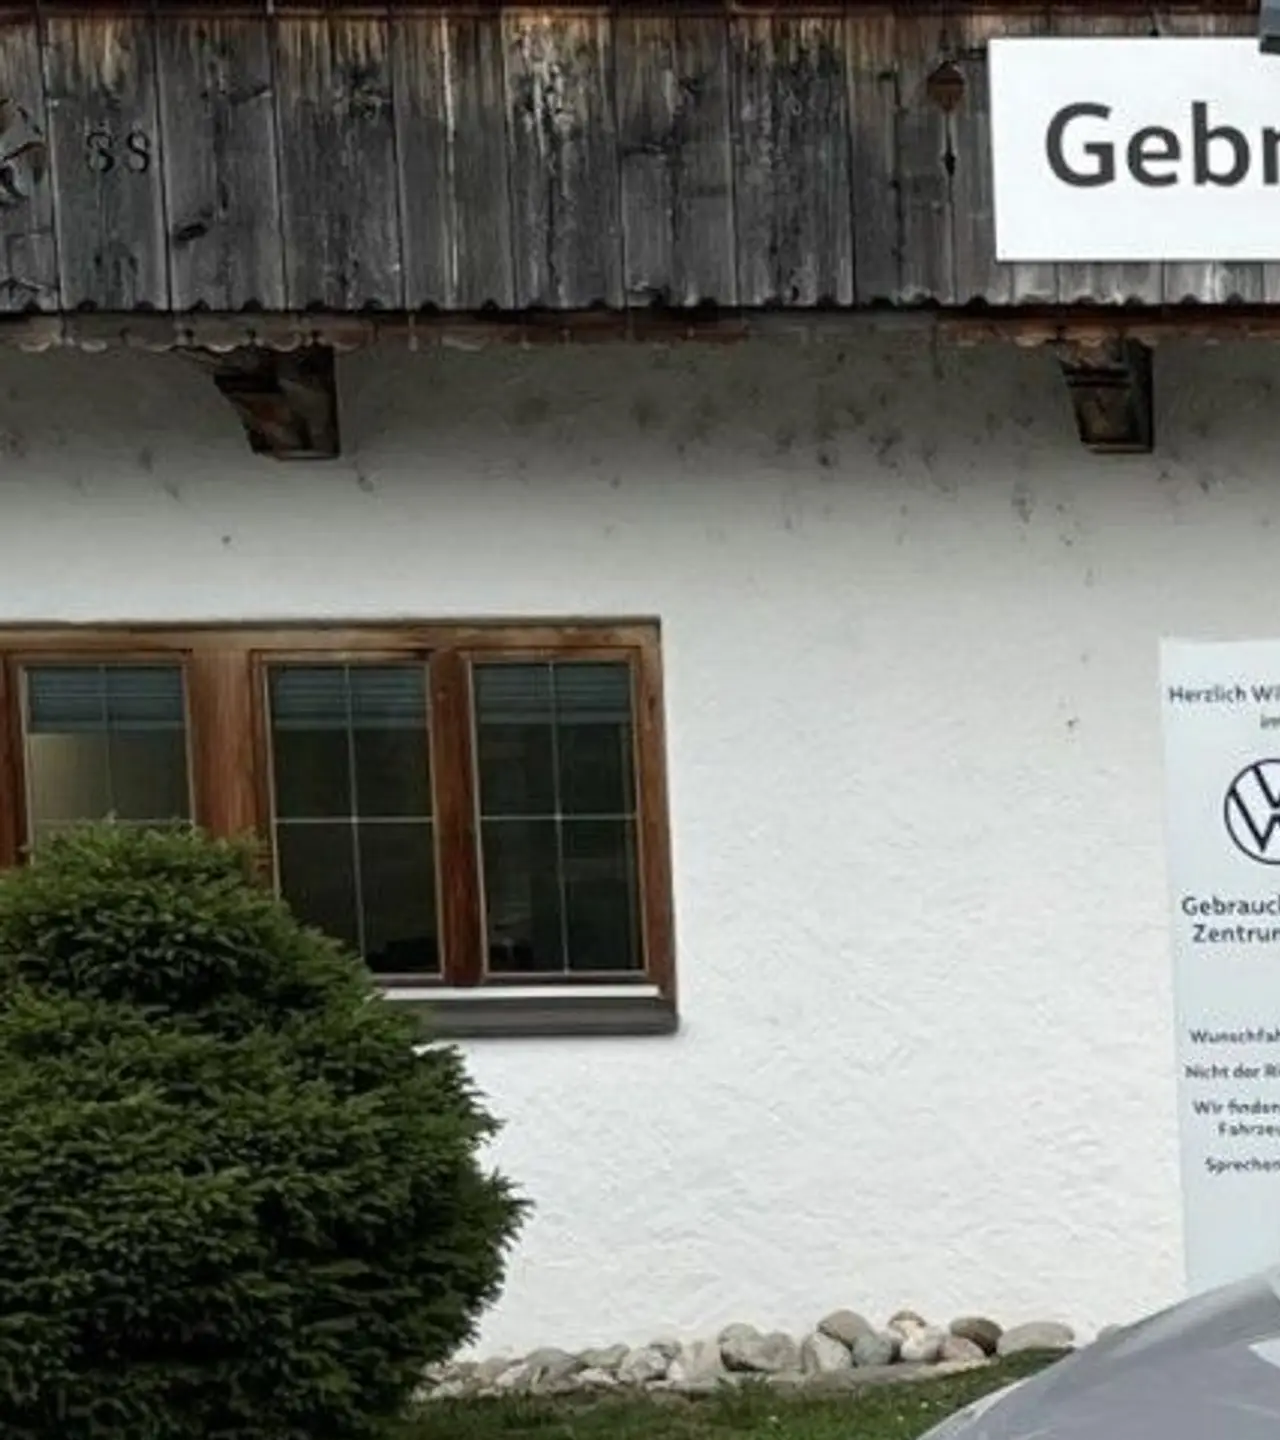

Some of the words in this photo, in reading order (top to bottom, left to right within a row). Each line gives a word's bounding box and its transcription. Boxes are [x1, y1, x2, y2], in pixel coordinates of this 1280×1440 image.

[1168, 685, 1247, 702] Herzlich
[1185, 1064, 1229, 1078] Nicht
[1233, 1064, 1260, 1078] der
[1192, 1101, 1223, 1114] Wir
